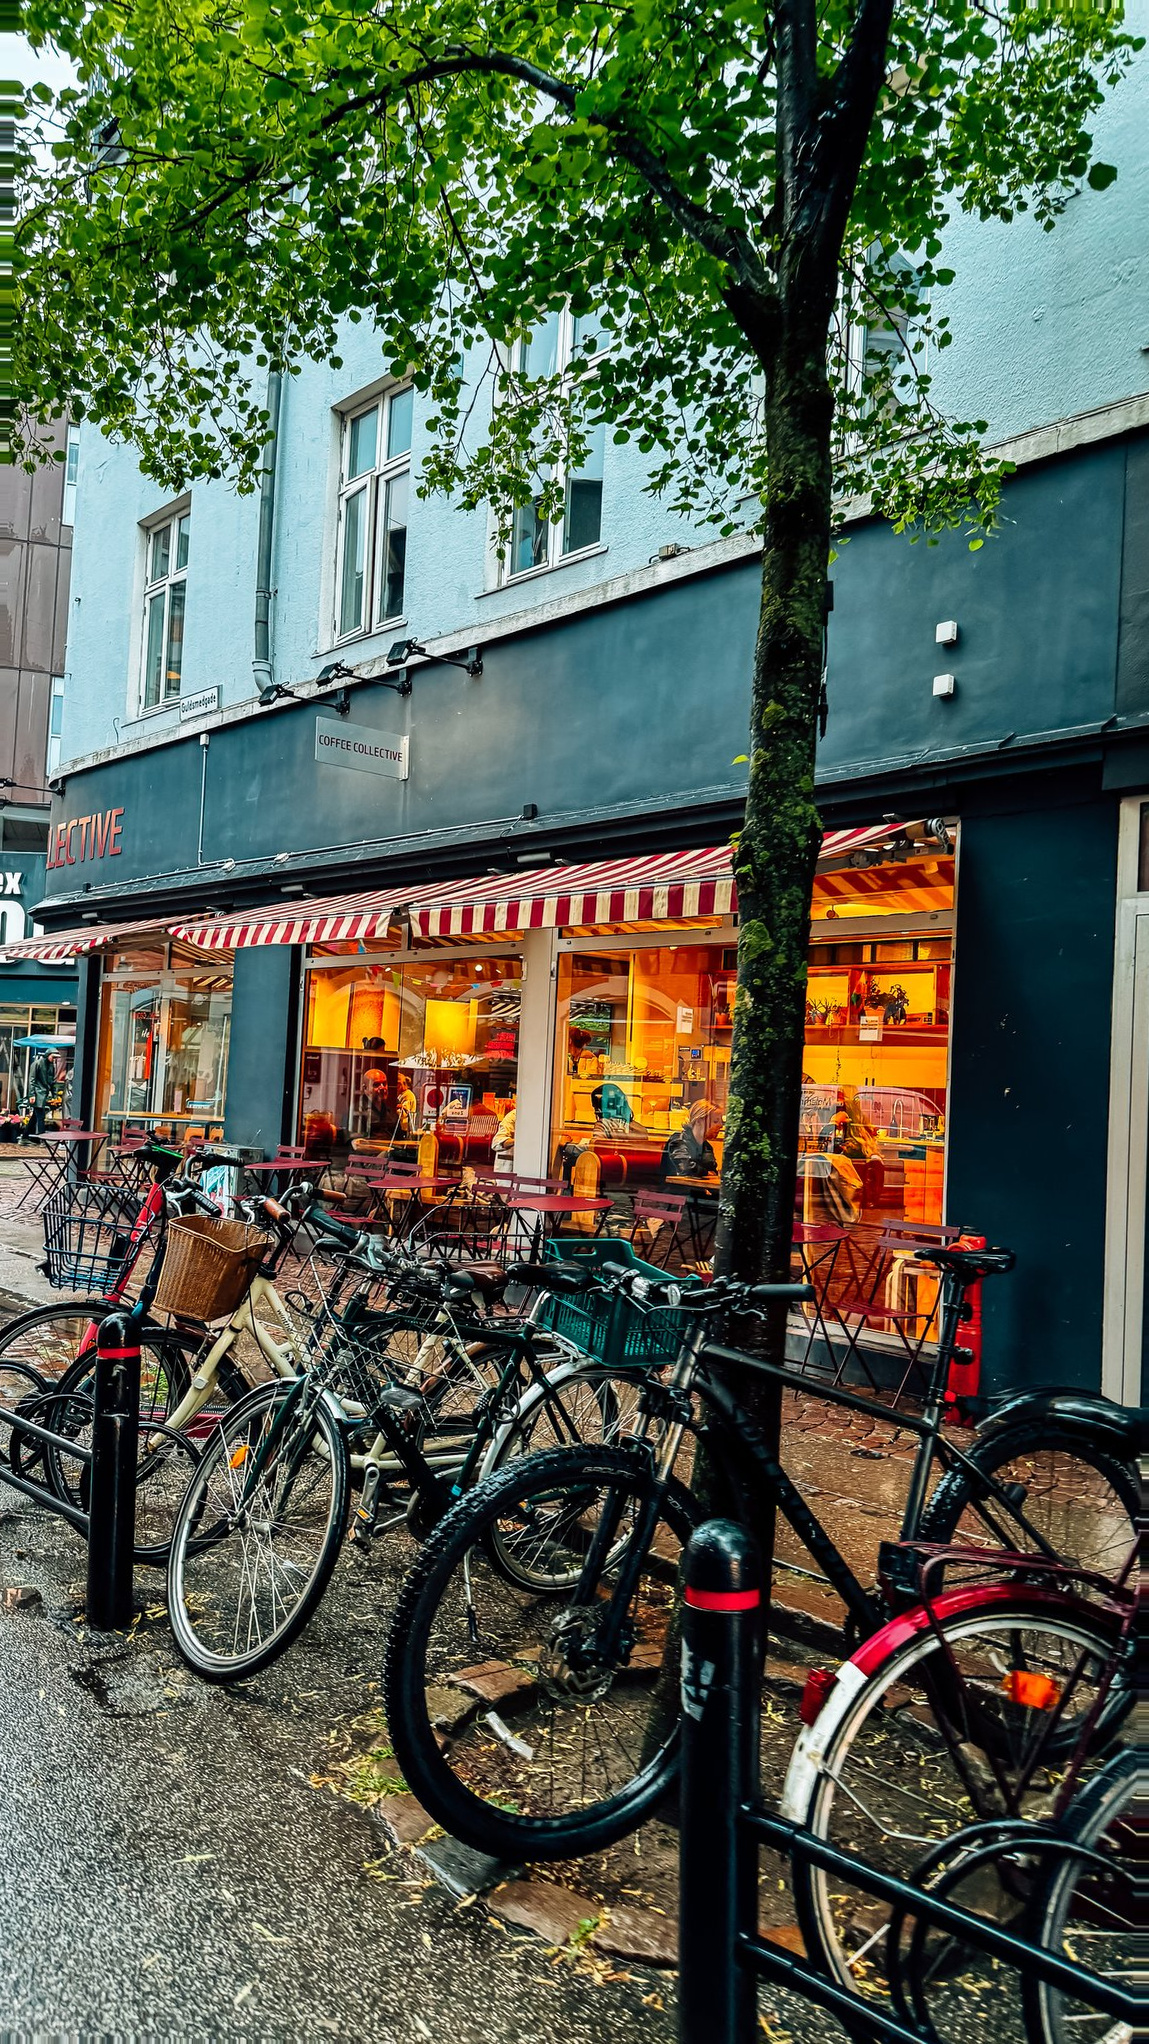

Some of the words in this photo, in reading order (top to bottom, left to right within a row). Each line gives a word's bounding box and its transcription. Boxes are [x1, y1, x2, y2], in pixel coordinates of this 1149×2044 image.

[318, 734, 351, 751] COFFEE
[353, 742, 403, 762] COLLECTIVE
[0, 871, 22, 895] x
